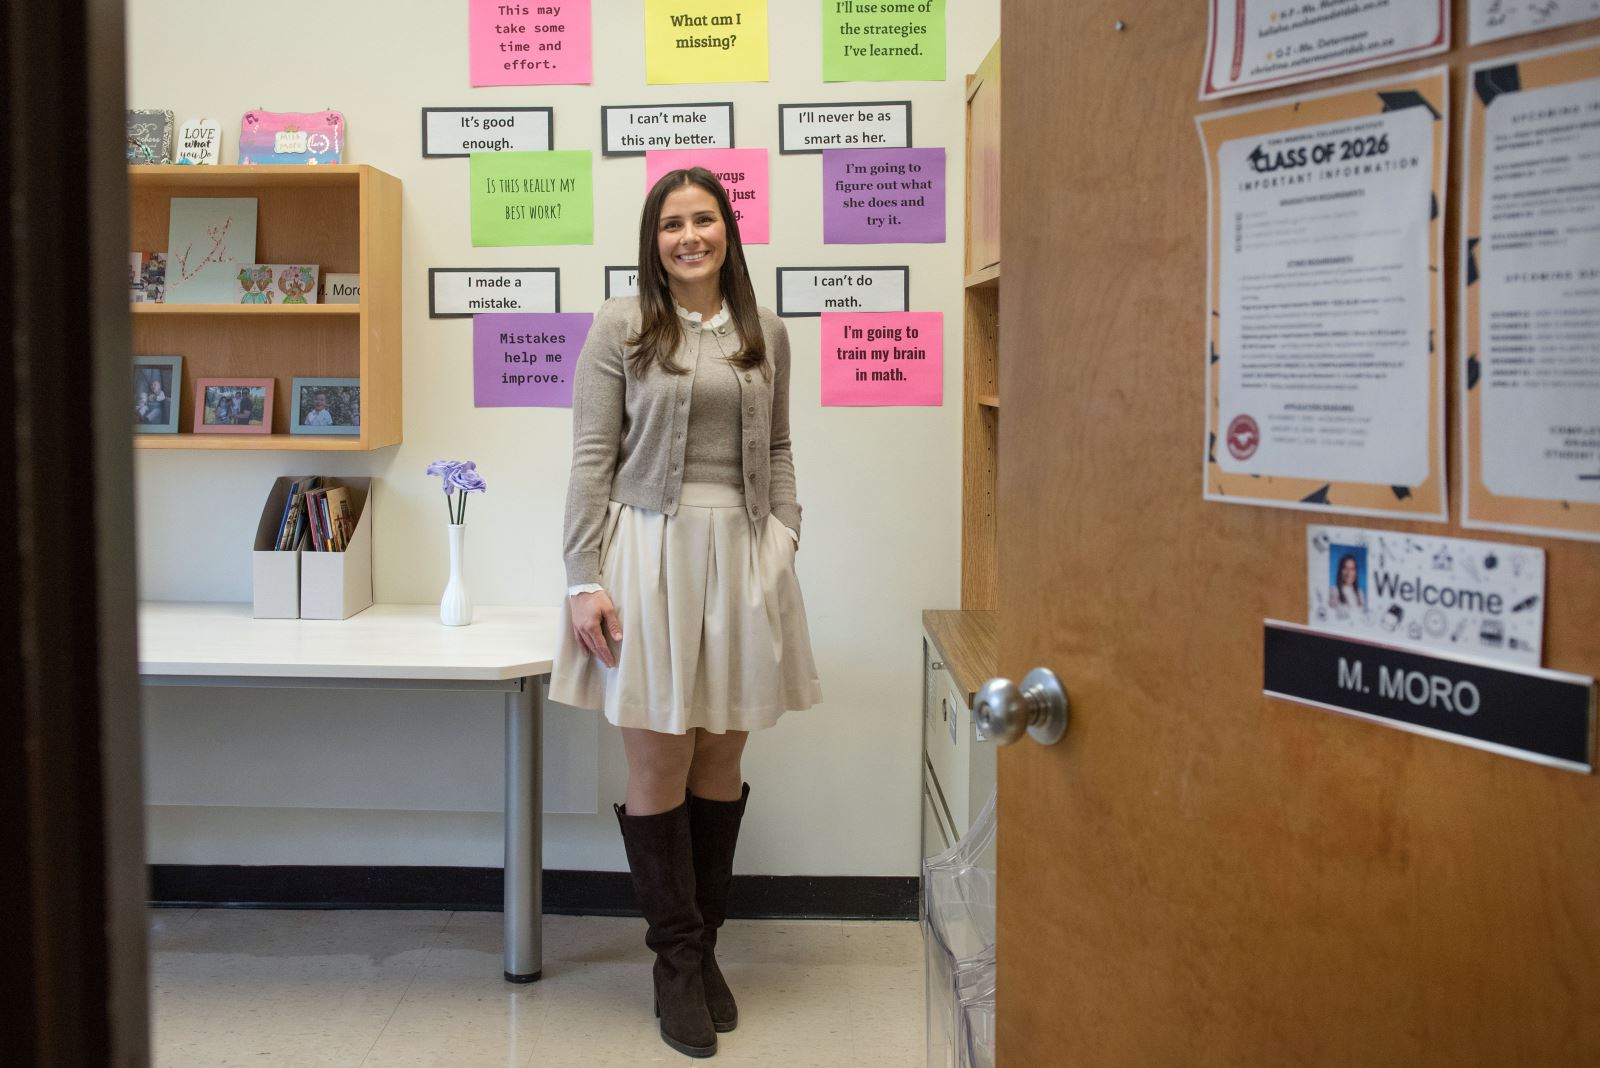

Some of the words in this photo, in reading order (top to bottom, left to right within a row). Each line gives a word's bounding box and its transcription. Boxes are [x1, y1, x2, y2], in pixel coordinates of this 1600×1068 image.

[498, 5, 529, 16] This
[537, 6, 561, 17] may
[836, 1, 853, 13] I'll
[856, 4, 878, 13] use
[880, 4, 915, 13] some
[917, 0, 933, 13] of
[670, 15, 708, 27] What
[711, 16, 734, 26] am
[736, 13, 742, 25] I
[495, 23, 526, 34] take
[534, 24, 565, 33] some
[840, 23, 861, 35] the
[863, 22, 927, 37] strategies
[499, 41, 530, 52] time
[538, 40, 562, 51] and
[676, 34, 737, 50] missing?
[844, 45, 867, 57] I've
[870, 44, 923, 57] learned.
[503, 59, 557, 70] effort.
[461, 116, 480, 128] It's
[483, 116, 515, 130] good
[630, 113, 634, 124] I
[637, 112, 669, 124] can't
[672, 112, 707, 123] make
[799, 112, 814, 123] I'll
[818, 113, 854, 123] never
[858, 110, 874, 121] be
[877, 112, 891, 121] as
[185, 128, 215, 139] LOVE
[621, 135, 645, 146] this
[648, 136, 671, 147] any
[674, 133, 716, 145] better.
[804, 133, 841, 144] smart
[845, 134, 859, 143] as
[862, 132, 886, 143] her.
[185, 140, 211, 148] what
[462, 137, 514, 151] enough.
[1253, 147, 1307, 173] CLASS
[1311, 143, 1335, 164] OF
[1340, 133, 1390, 161] 2026
[846, 163, 867, 174] I'm
[870, 162, 906, 176] going
[908, 163, 922, 173] to
[1239, 173, 1313, 192] IMPORTANT
[1319, 156, 1420, 180] INFORMATION
[712, 171, 745, 183] ways
[835, 181, 874, 193] figure
[876, 180, 898, 190] out
[900, 179, 932, 190] what
[731, 189, 756, 202] just
[842, 197, 865, 208] she
[868, 196, 898, 208] does
[900, 196, 925, 207] and
[867, 216, 885, 228] try
[888, 214, 901, 225] it.
[468, 277, 471, 287] I
[475, 276, 511, 287] made
[514, 279, 522, 287] a
[628, 275, 639, 286] I'
[814, 276, 818, 286] I
[821, 275, 853, 286] can't
[856, 274, 873, 286] do
[468, 298, 521, 309] mistake.
[825, 296, 862, 308] math.
[500, 332, 566, 344] Mistakes
[844, 325, 863, 339] I'm
[867, 326, 902, 341] going
[905, 326, 919, 339] to
[504, 351, 537, 365] help
[545, 353, 562, 363] me
[837, 347, 867, 360] train
[871, 349, 889, 362] my
[893, 346, 926, 360] brain
[501, 372, 565, 386] improve.
[855, 368, 867, 381] in
[871, 368, 907, 381] math.
[1373, 570, 1504, 615] Welcome
[1337, 657, 1371, 694] M.
[1378, 665, 1481, 717] MORO
